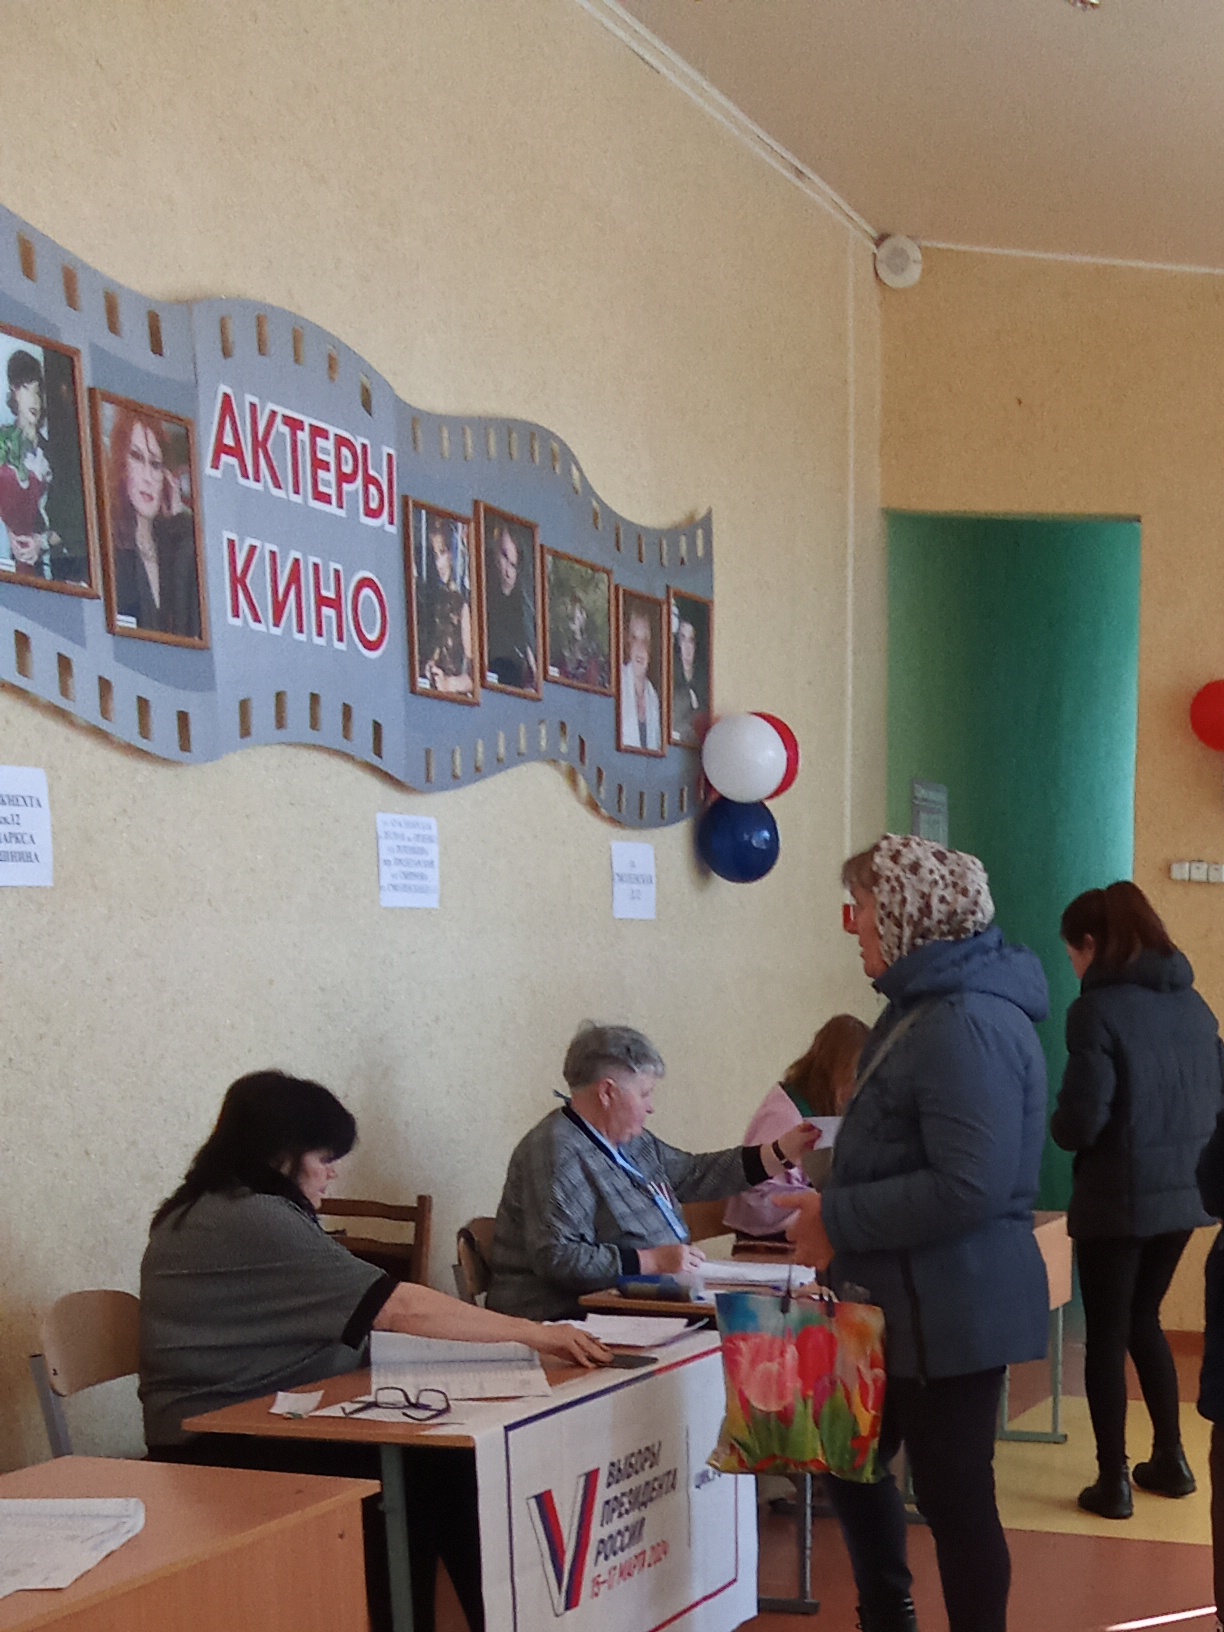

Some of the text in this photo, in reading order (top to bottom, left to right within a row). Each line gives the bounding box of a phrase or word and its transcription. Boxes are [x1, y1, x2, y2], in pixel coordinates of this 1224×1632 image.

[208, 388, 398, 529] АКТЕРЫ
[225, 534, 391, 656] КИНО
[0, 831, 36, 845] АРКСА
[605, 1440, 662, 1489] ВЫБОРЫ
[600, 1467, 678, 1528] ПРЕЗИДЕНТА
[594, 1517, 646, 1567] РОССИИ
[618, 1549, 647, 1585] МАРТА
